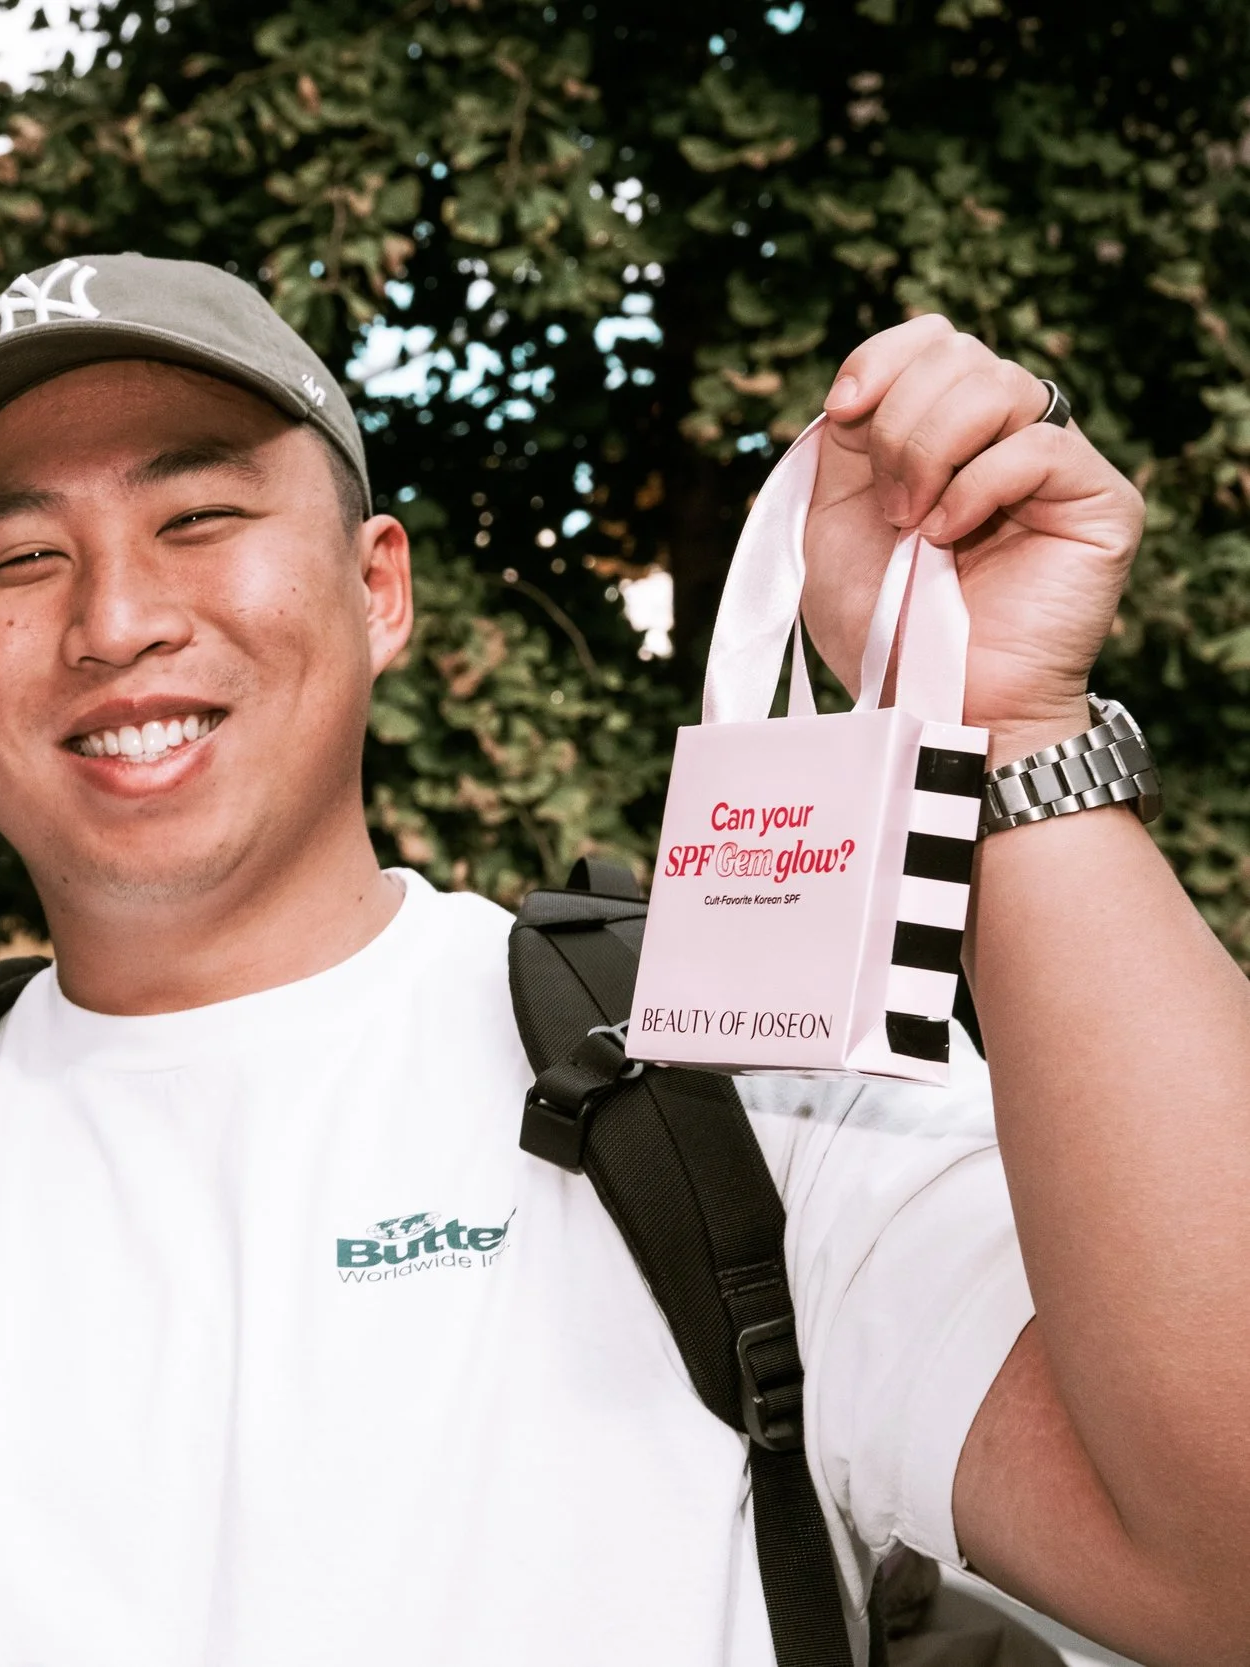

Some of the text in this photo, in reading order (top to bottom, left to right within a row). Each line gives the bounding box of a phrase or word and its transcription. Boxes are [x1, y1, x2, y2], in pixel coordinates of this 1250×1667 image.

[711, 802, 814, 837] Can your
[664, 838, 856, 884] SPF Gem glow?
[704, 893, 801, 906] Cult-Favorite Korean SPF
[641, 1007, 833, 1040] BEAUTY OF JOSEON
[338, 1251, 473, 1284] Worldwide
